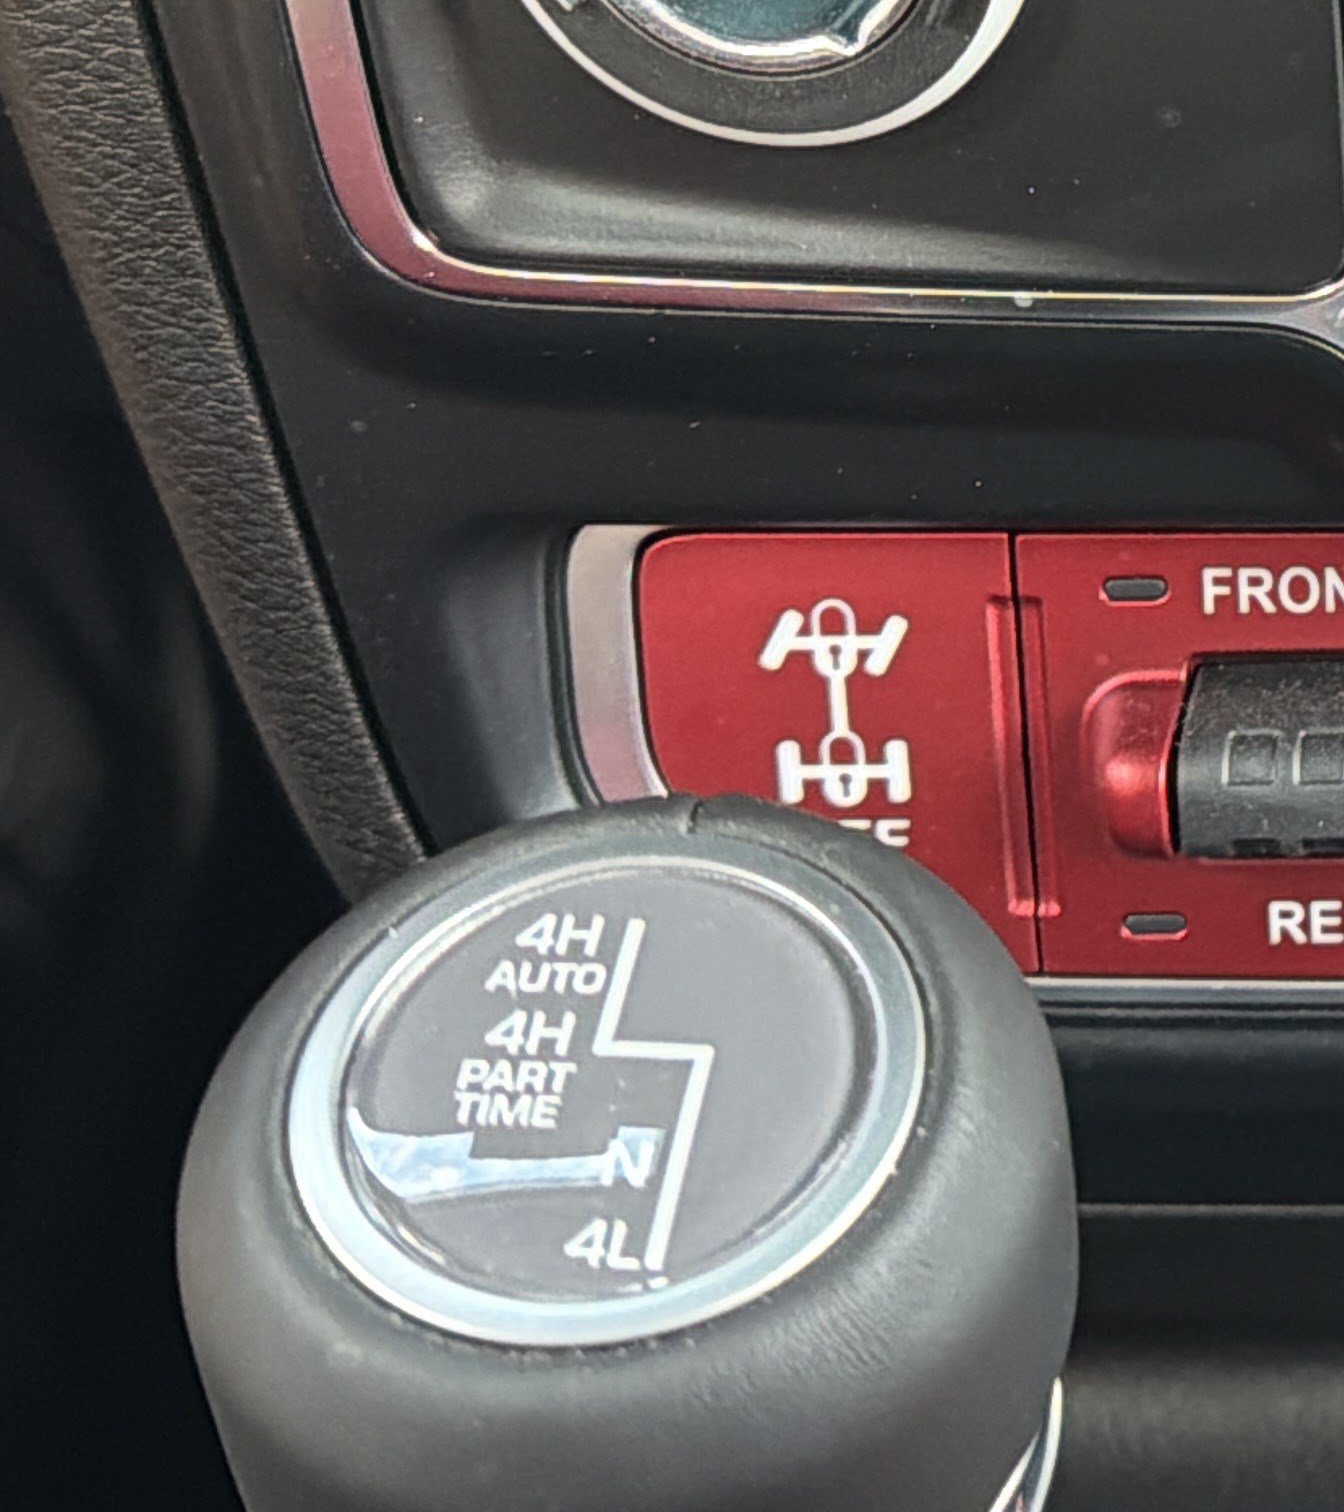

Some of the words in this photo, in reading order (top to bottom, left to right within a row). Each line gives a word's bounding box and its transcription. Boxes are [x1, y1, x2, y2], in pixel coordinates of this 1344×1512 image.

[515, 912, 606, 957] 4H
[485, 960, 605, 996] AUTO
[484, 1008, 577, 1057] 4H
[455, 1059, 578, 1093] PART
[454, 1092, 562, 1129] TIME
[602, 1137, 652, 1187] N
[564, 1218, 641, 1270] 4L
